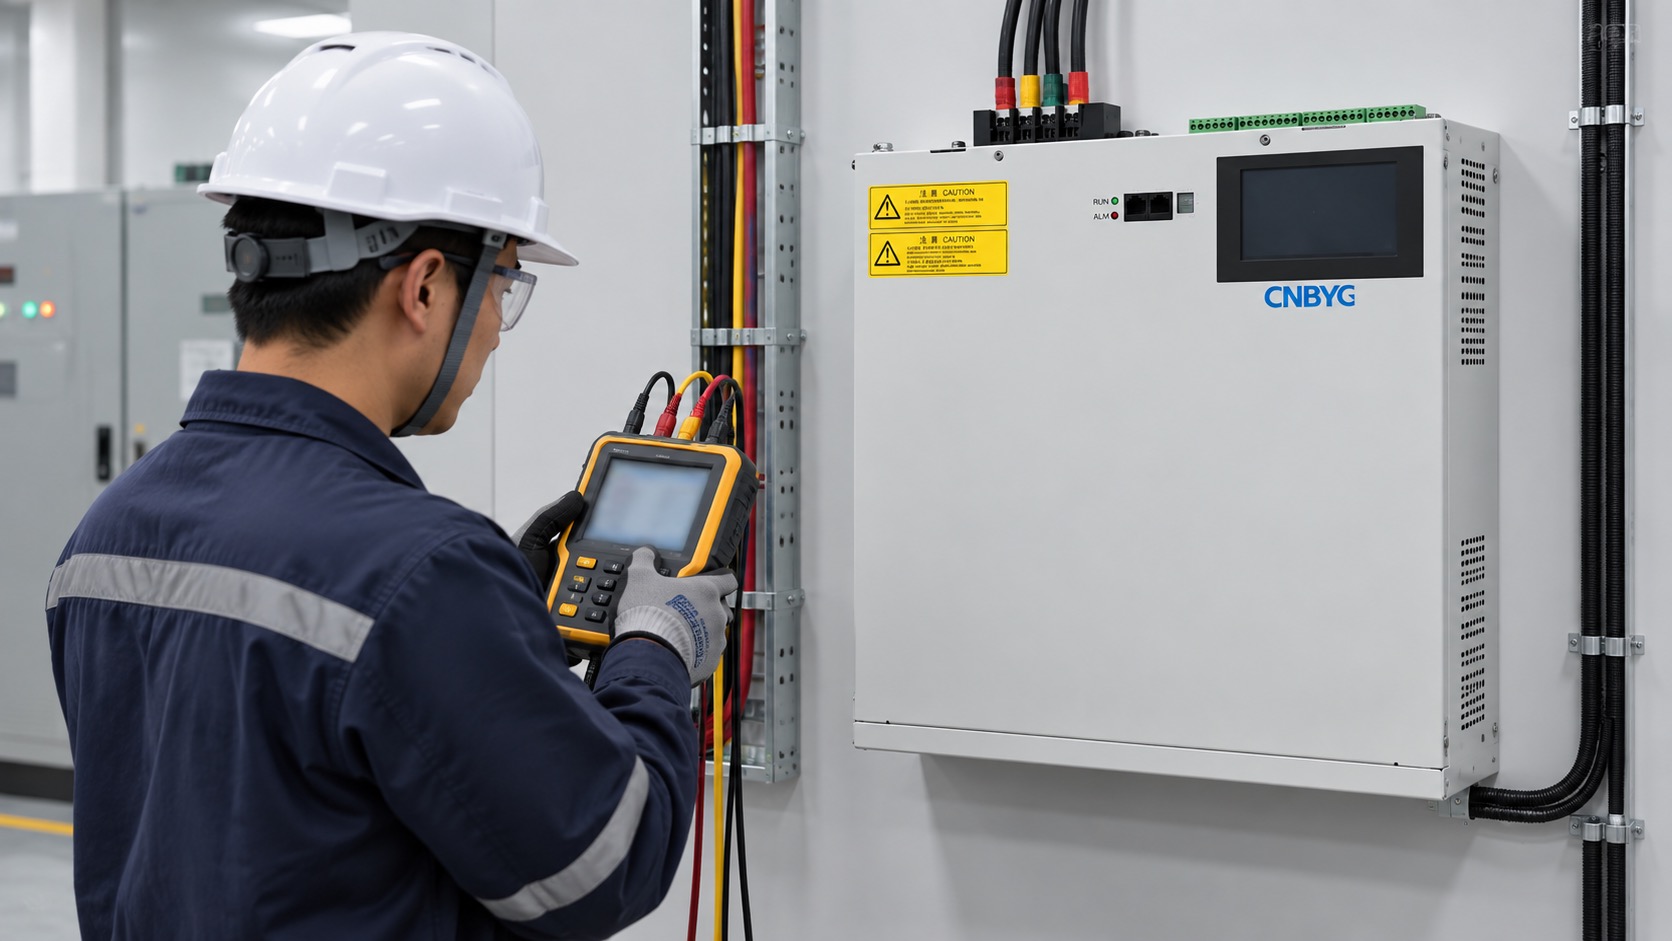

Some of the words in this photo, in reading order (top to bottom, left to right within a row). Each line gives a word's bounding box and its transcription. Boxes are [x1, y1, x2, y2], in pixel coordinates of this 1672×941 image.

[942, 188, 975, 197] CAUTION
[942, 235, 975, 244] CAUTION
[1264, 284, 1355, 309] CNBYG
